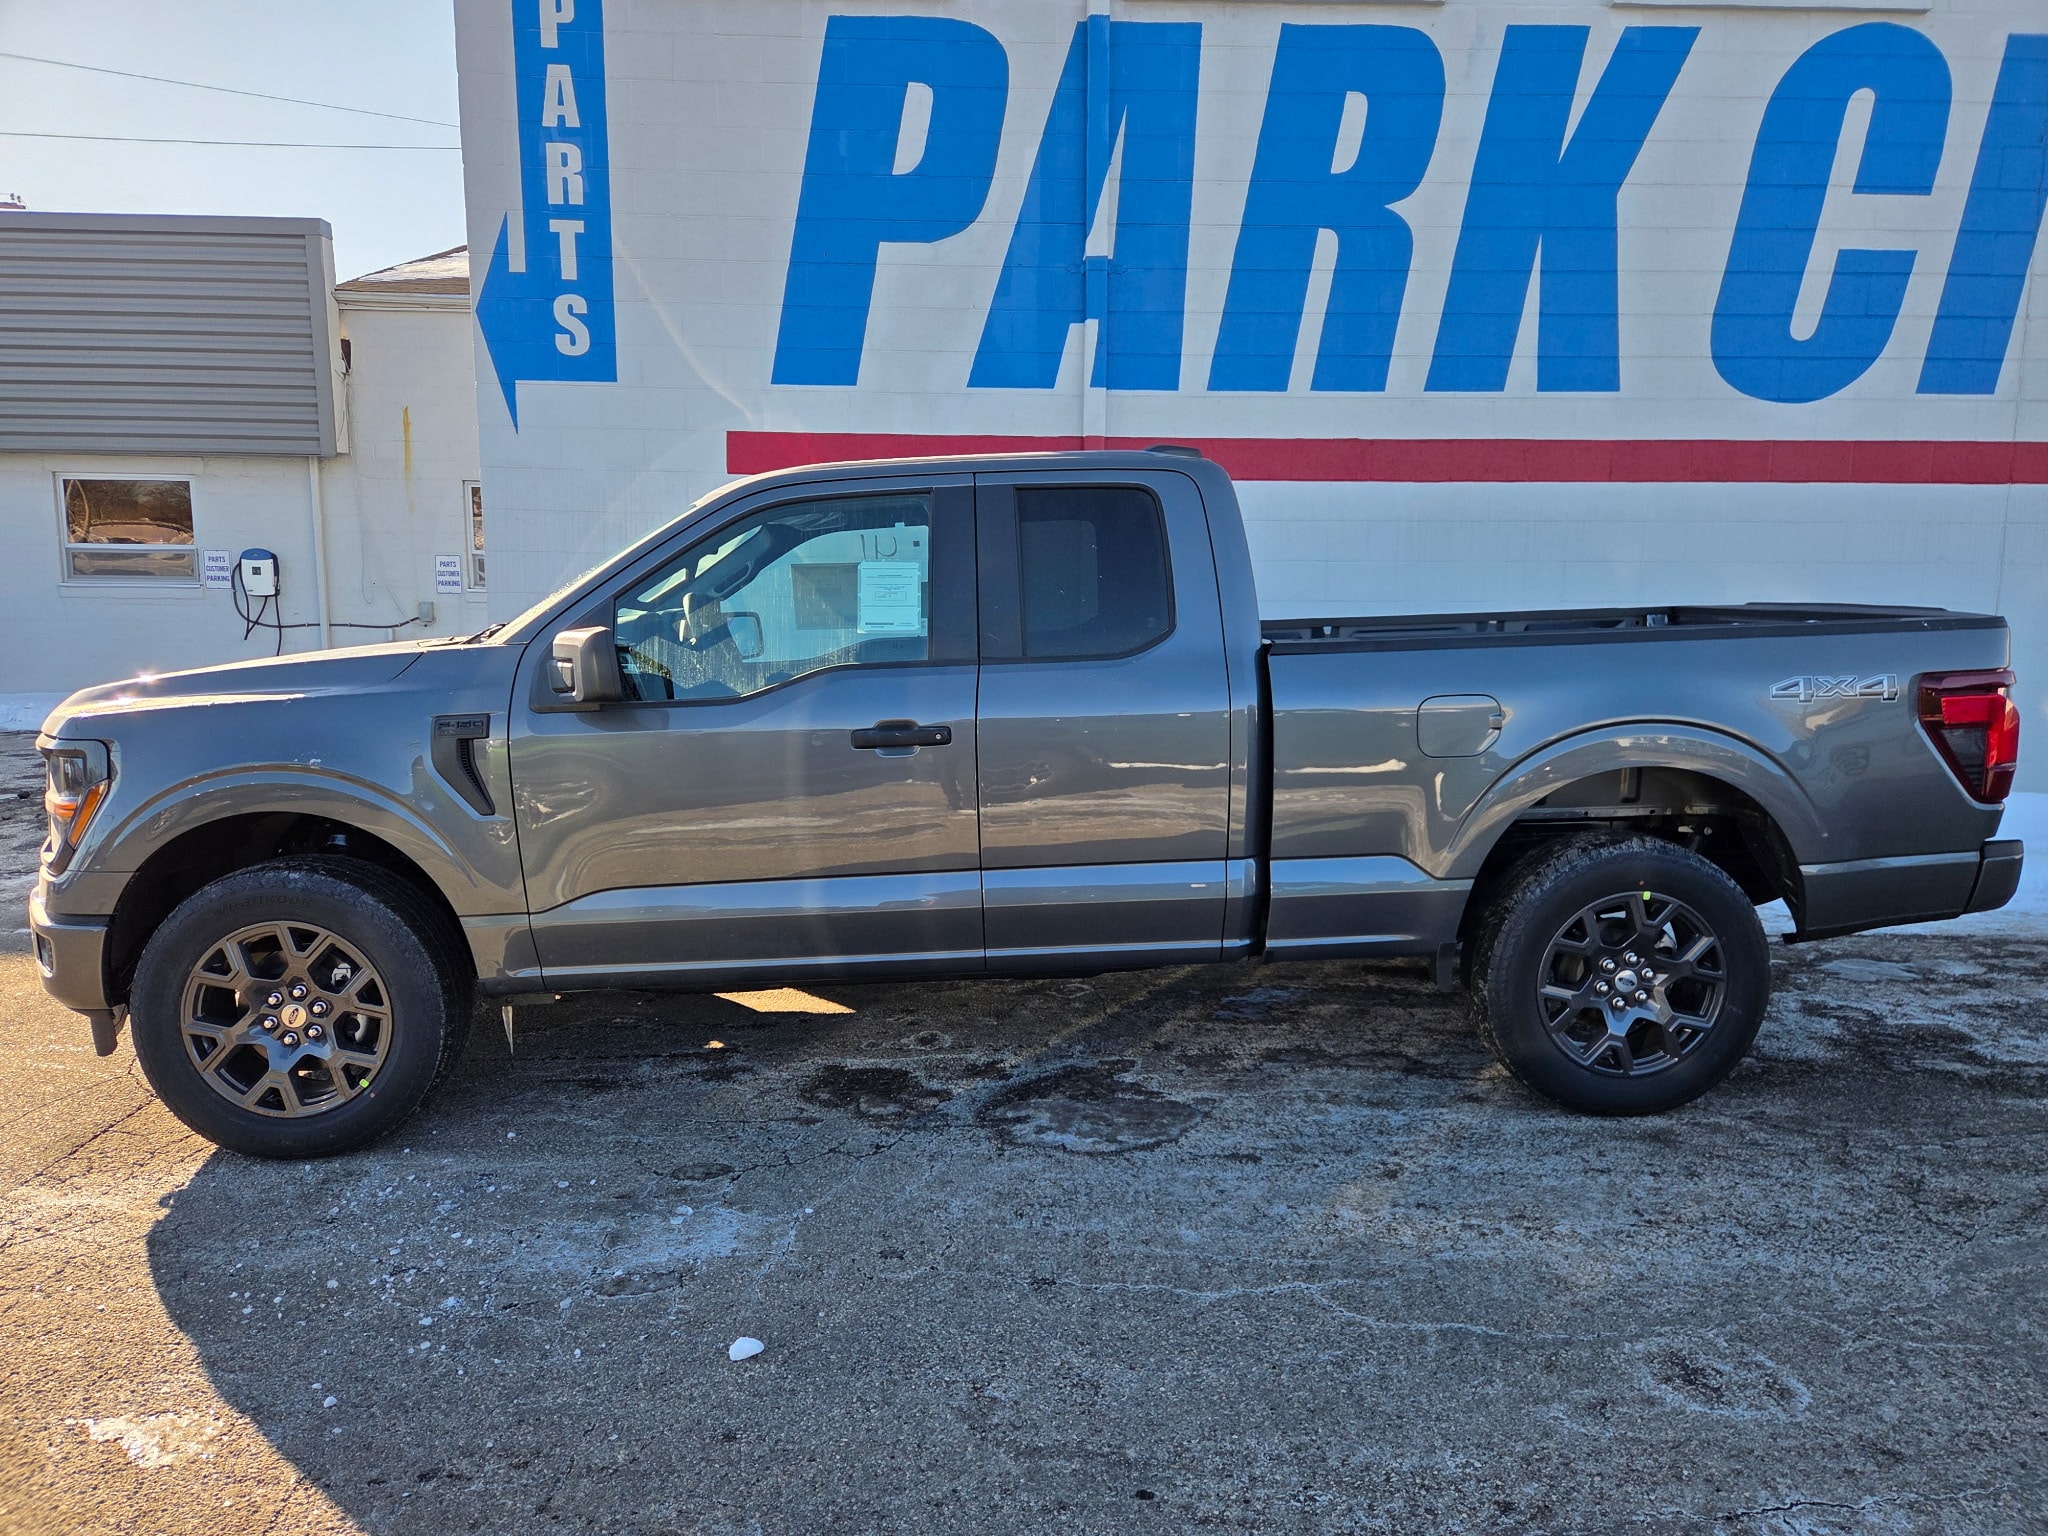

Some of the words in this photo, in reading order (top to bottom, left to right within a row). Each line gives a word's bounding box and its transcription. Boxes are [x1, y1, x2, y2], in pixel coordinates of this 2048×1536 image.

[540, 0, 591, 356] PARTS
[771, 17, 1702, 393] PARK
[1711, 21, 2048, 404] CI
[206, 575, 230, 583] PARKING
